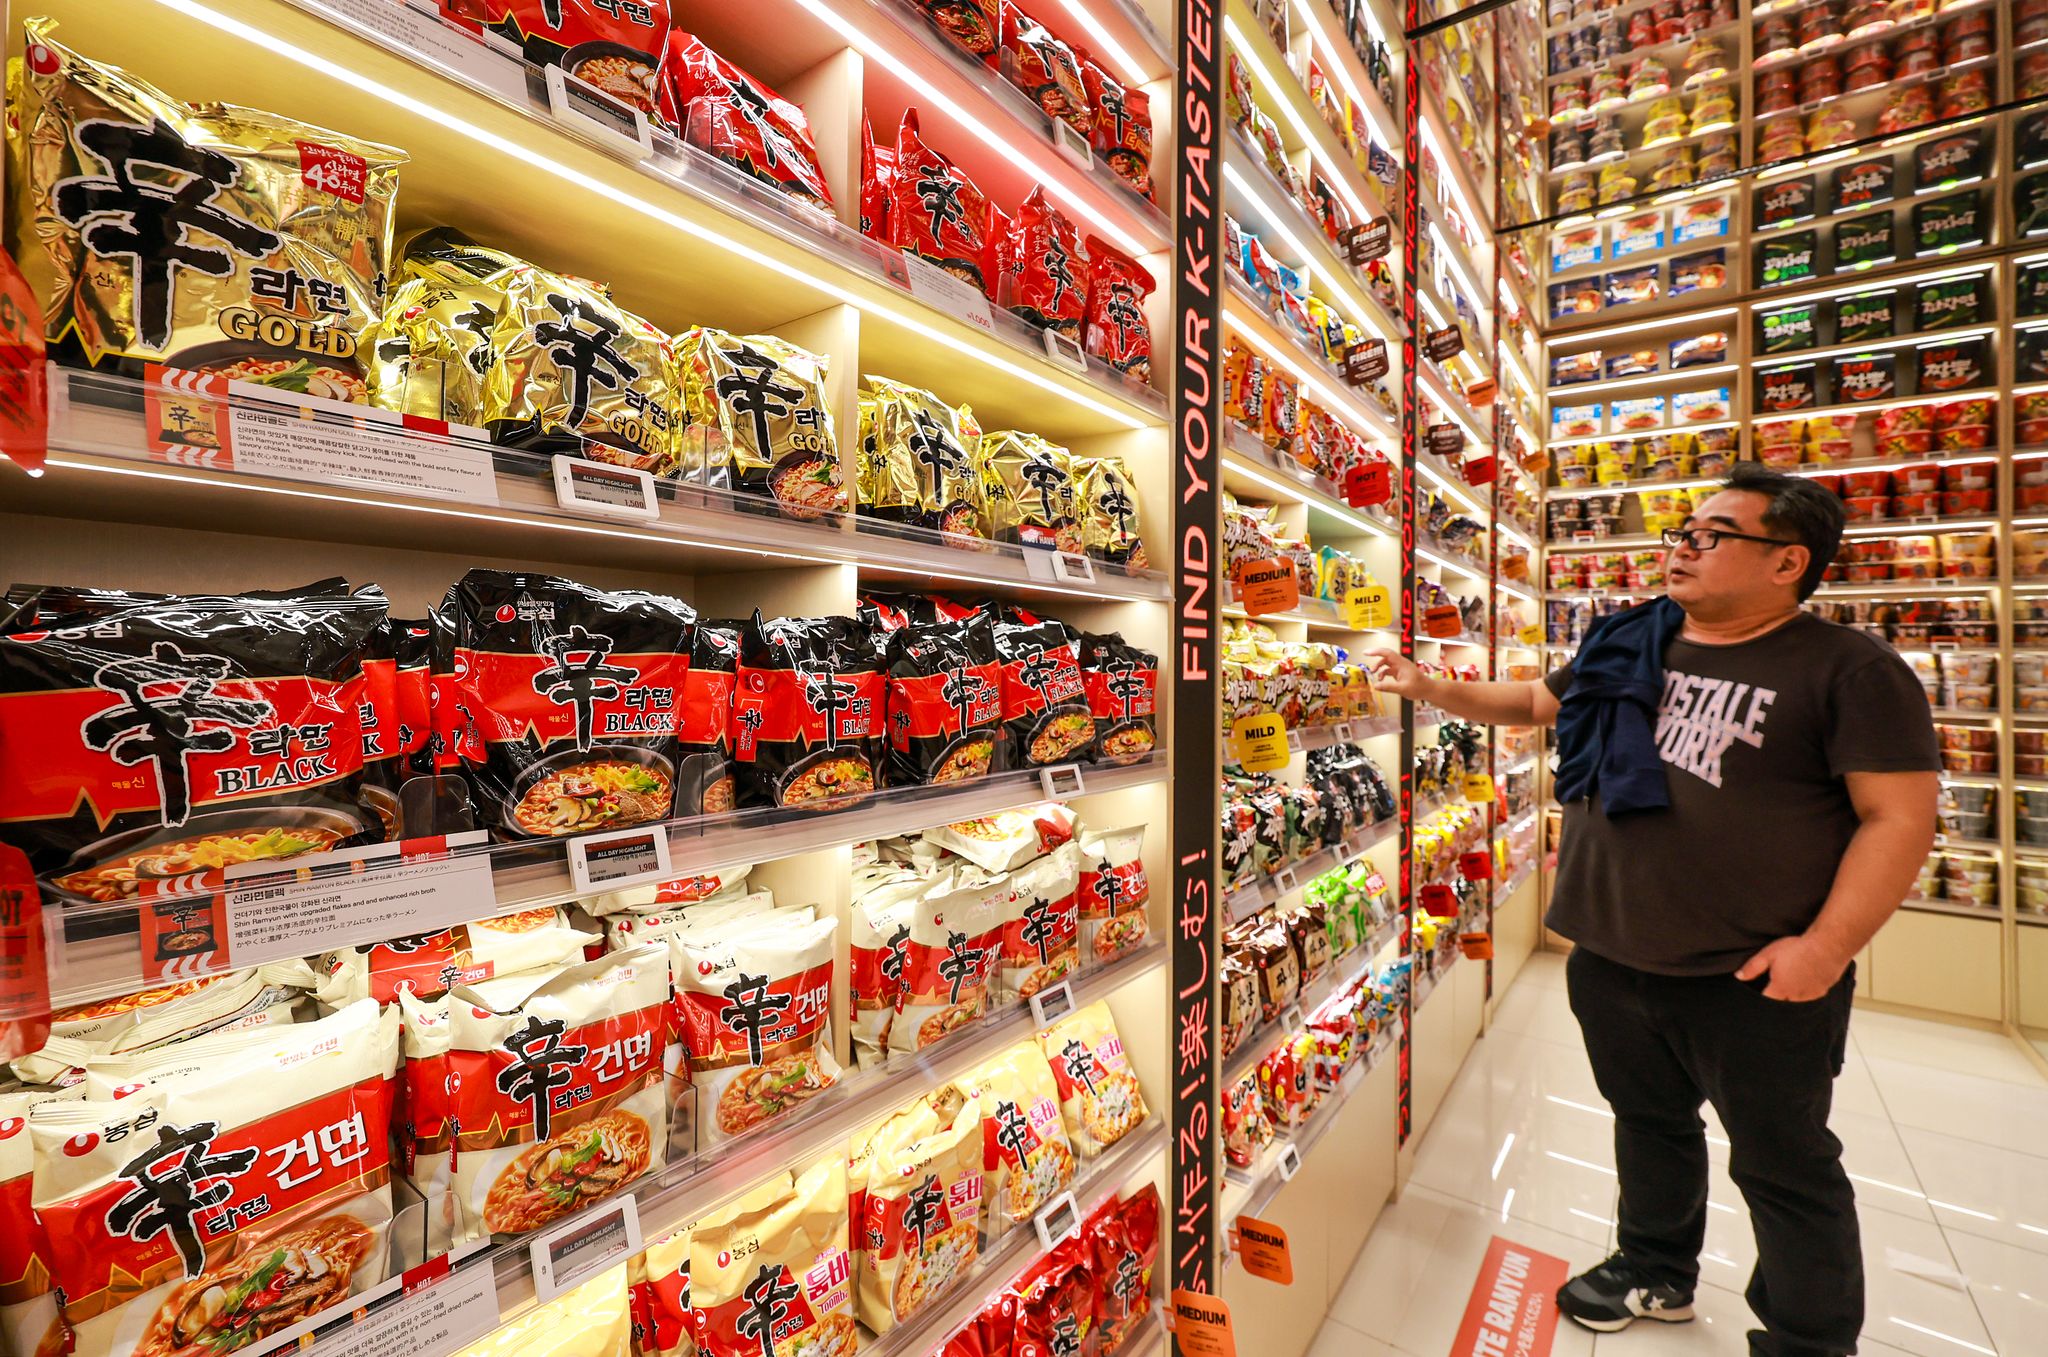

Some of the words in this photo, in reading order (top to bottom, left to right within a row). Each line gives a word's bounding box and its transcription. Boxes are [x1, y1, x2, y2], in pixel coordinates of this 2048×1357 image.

[1101, 80, 1132, 144] 辛
[304, 163, 341, 191] 40
[916, 164, 964, 249] 辛
[53, 116, 283, 351] 辛
[248, 265, 352, 317] 라면
[1043, 234, 1073, 313] 辛
[217, 304, 358, 360] GOLD
[1106, 277, 1140, 353] 辛
[533, 291, 641, 431] 辛
[236, 411, 289, 427] 신라면골드
[716, 344, 806, 463] 辛
[1183, 306, 1211, 504] YOUR
[238, 441, 261, 450] savory
[263, 445, 292, 454] chicken.
[608, 408, 666, 458] GOLD
[237, 434, 254, 442] Shin
[255, 436, 291, 448] Ramyun's
[292, 443, 323, 453] signature
[324, 448, 341, 457] spicy
[342, 450, 358, 459] kick,
[358, 453, 372, 461] now
[373, 455, 397, 464] infused
[397, 458, 411, 466] with
[447, 466, 460, 474] fiery
[460, 468, 475, 476] flavor
[910, 410, 964, 506] 辛
[605, 480, 634, 489] HIGHLIGHT
[1022, 452, 1067, 523] 辛
[1354, 470, 1378, 484] HOT
[624, 499, 645, 509] 1,500
[1101, 471, 1135, 546] 辛
[1244, 567, 1291, 586] MEDIUM
[516, 605, 556, 622] 농심
[1181, 525, 1209, 681] FIND
[1354, 594, 1381, 606] MILD
[531, 624, 640, 753] 辛
[937, 650, 984, 740] 辛
[1014, 642, 1059, 715] 辛
[1050, 681, 1085, 701] BLACK
[1053, 665, 1079, 684] 라면
[1106, 656, 1145, 725] 辛
[624, 685, 673, 709] 라면
[799, 659, 857, 752] 辛
[80, 641, 275, 828] 辛
[247, 720, 333, 758] 라면
[604, 708, 675, 734] BLACK
[1245, 725, 1276, 741] MILD
[214, 753, 337, 797] BLACK
[618, 844, 647, 855] HIGHLIGHT
[638, 861, 657, 872] 1,900
[233, 887, 285, 905] 신라면블랙
[233, 909, 262, 920] 건더기와
[264, 902, 299, 915] 진한국물이
[300, 899, 321, 909] 강화된
[322, 895, 342, 904] 신라면
[234, 919, 250, 928] Shin
[252, 915, 282, 927] Ramyun
[283, 911, 298, 920] with
[300, 906, 331, 918] upgraded
[332, 903, 351, 912] flakes
[366, 897, 378, 905] and
[378, 893, 408, 903] enhanced
[420, 887, 436, 896] broth
[1093, 857, 1124, 918] 辛
[1021, 897, 1061, 966] 辛
[438, 964, 465, 995] 辛
[465, 967, 487, 981] 건면
[939, 930, 984, 1005] 辛
[241, 1012, 268, 1028] 건면
[719, 972, 791, 1067] 辛
[793, 979, 830, 1024] 건면
[82, 1022, 102, 1036] kcal)
[311, 1036, 340, 1058] 건면
[765, 1022, 798, 1045] 라면
[591, 1029, 653, 1080] 건면
[1062, 1038, 1098, 1097] 辛
[495, 1016, 588, 1144] 辛
[554, 1083, 593, 1111] 라면
[103, 1105, 159, 1144] 농심
[995, 1101, 1028, 1171] 辛
[266, 1110, 370, 1190] 건면
[104, 1120, 259, 1281] 辛
[948, 1174, 984, 1208] 툼바
[204, 1194, 272, 1236] 라면
[902, 1173, 945, 1258] 辛
[563, 1245, 575, 1256] ALL
[574, 1240, 587, 1250] DAY
[586, 1223, 616, 1243] HIGHLIGHT
[732, 1238, 761, 1261] 농심
[1240, 1227, 1284, 1249] MEDIUM
[417, 1277, 432, 1291] HOT
[1113, 1250, 1141, 1319] 辛
[1484, 1250, 1532, 1334] RAMYUN
[369, 1339, 394, 1354] Ramyun
[395, 1330, 409, 1341] with
[409, 1324, 419, 1334] it's
[419, 1310, 447, 1327] non-fried
[447, 1303, 462, 1314] dried
[462, 1291, 484, 1306] noodles
[413, 1314, 419, 1323] 수
[420, 1310, 432, 1318] 있는
[433, 1301, 445, 1311] 제품
[736, 1263, 801, 1357] 辛
[775, 1314, 804, 1338] 라면
[1176, 1303, 1227, 1327] MEDIUM
